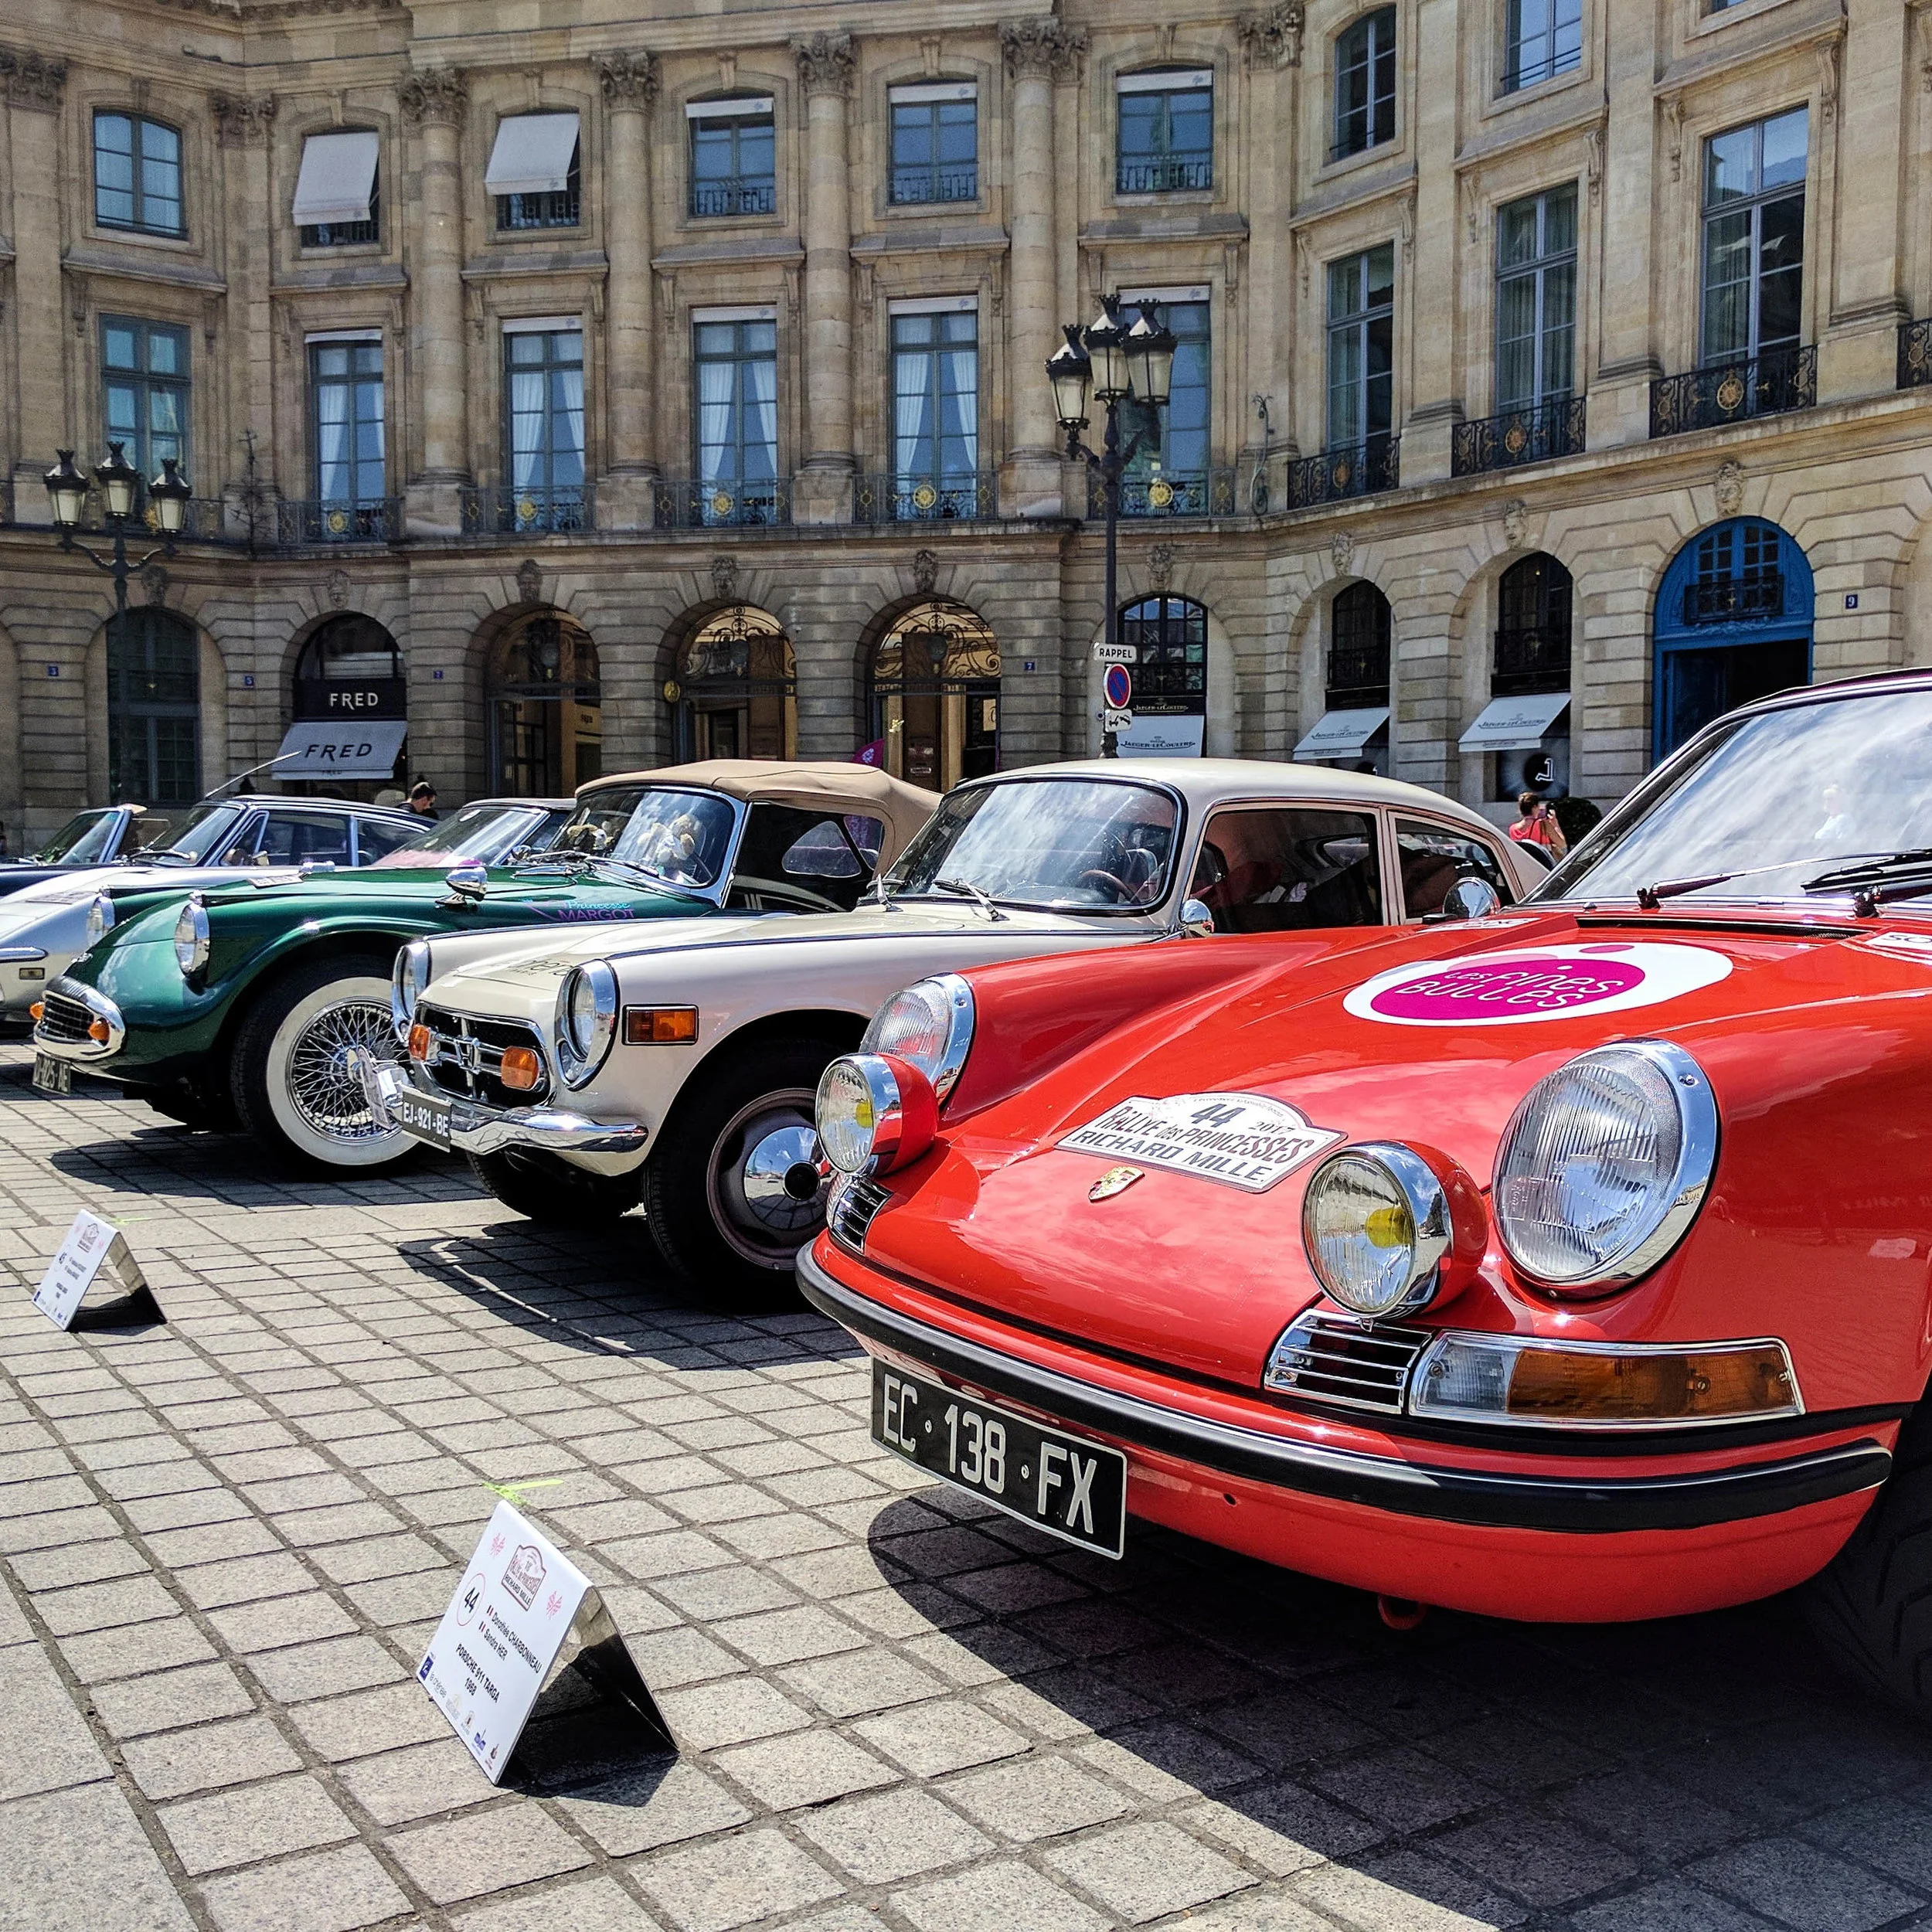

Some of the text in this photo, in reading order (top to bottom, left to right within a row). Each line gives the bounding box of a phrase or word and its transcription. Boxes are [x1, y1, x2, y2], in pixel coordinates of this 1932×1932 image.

[1099, 648, 1133, 658] RAPPEL
[330, 692, 379, 710] FRED
[304, 743, 372, 761] FRED
[558, 908, 635, 921] MARGOT
[1190, 1103, 1247, 1128] 44
[1248, 1121, 1296, 1134] 2017
[1071, 1131, 1273, 1181] RICHARD MILLE
[1154, 1124, 1184, 1140] des
[1175, 1128, 1315, 1164] PRINCESSES
[464, 1587, 480, 1614] 44
[484, 1628, 508, 1661] Sandra HER
[508, 1631, 542, 1674] CHARBONNEAU
[455, 1643, 500, 1703] PORSCHE 911 TARGA
[464, 1677, 477, 1696] 1968
